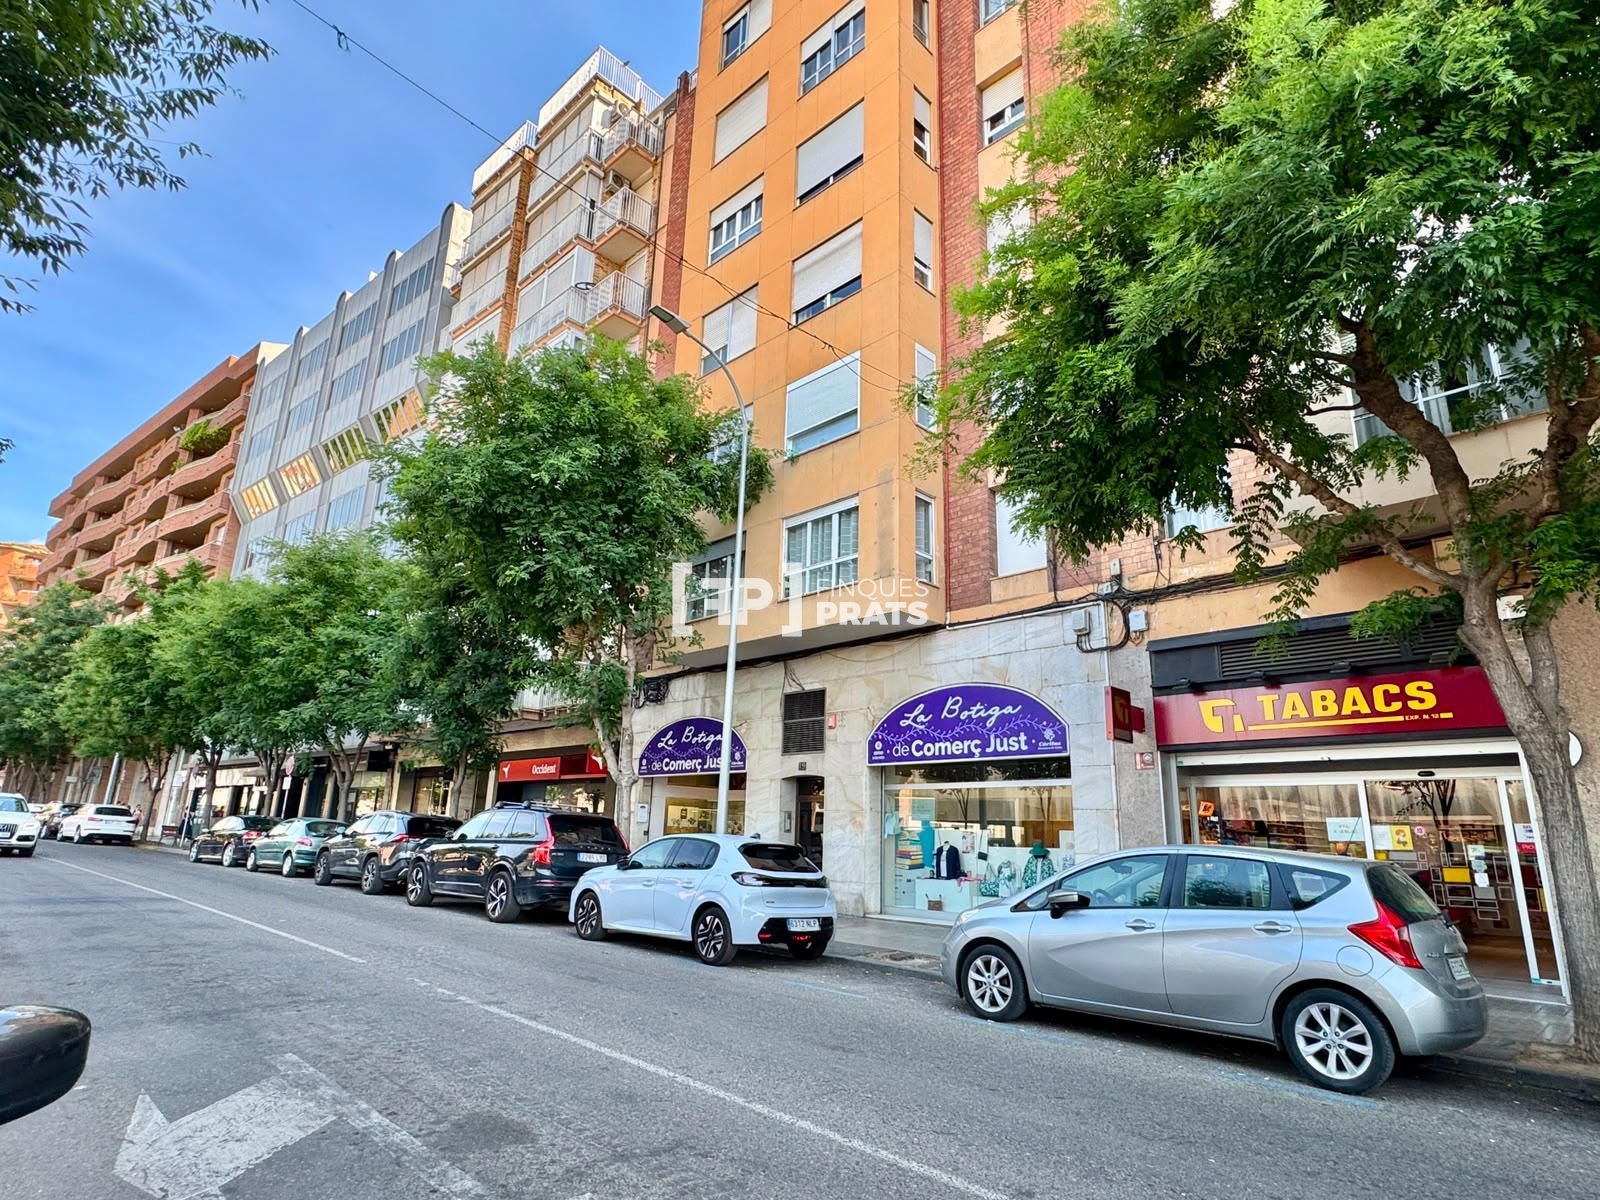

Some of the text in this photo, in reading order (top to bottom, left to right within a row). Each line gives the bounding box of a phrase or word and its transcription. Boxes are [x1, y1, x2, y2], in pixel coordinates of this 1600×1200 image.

[899, 695, 1022, 729] La Botiga
[1256, 680, 1437, 721] TABACS
[657, 725, 724, 751] La Botiga
[892, 731, 1029, 758] de Comerç Just
[532, 764, 557, 775] Occident
[651, 761, 662, 771] de
[662, 758, 703, 773] Comerç
[703, 755, 722, 769] Jus
